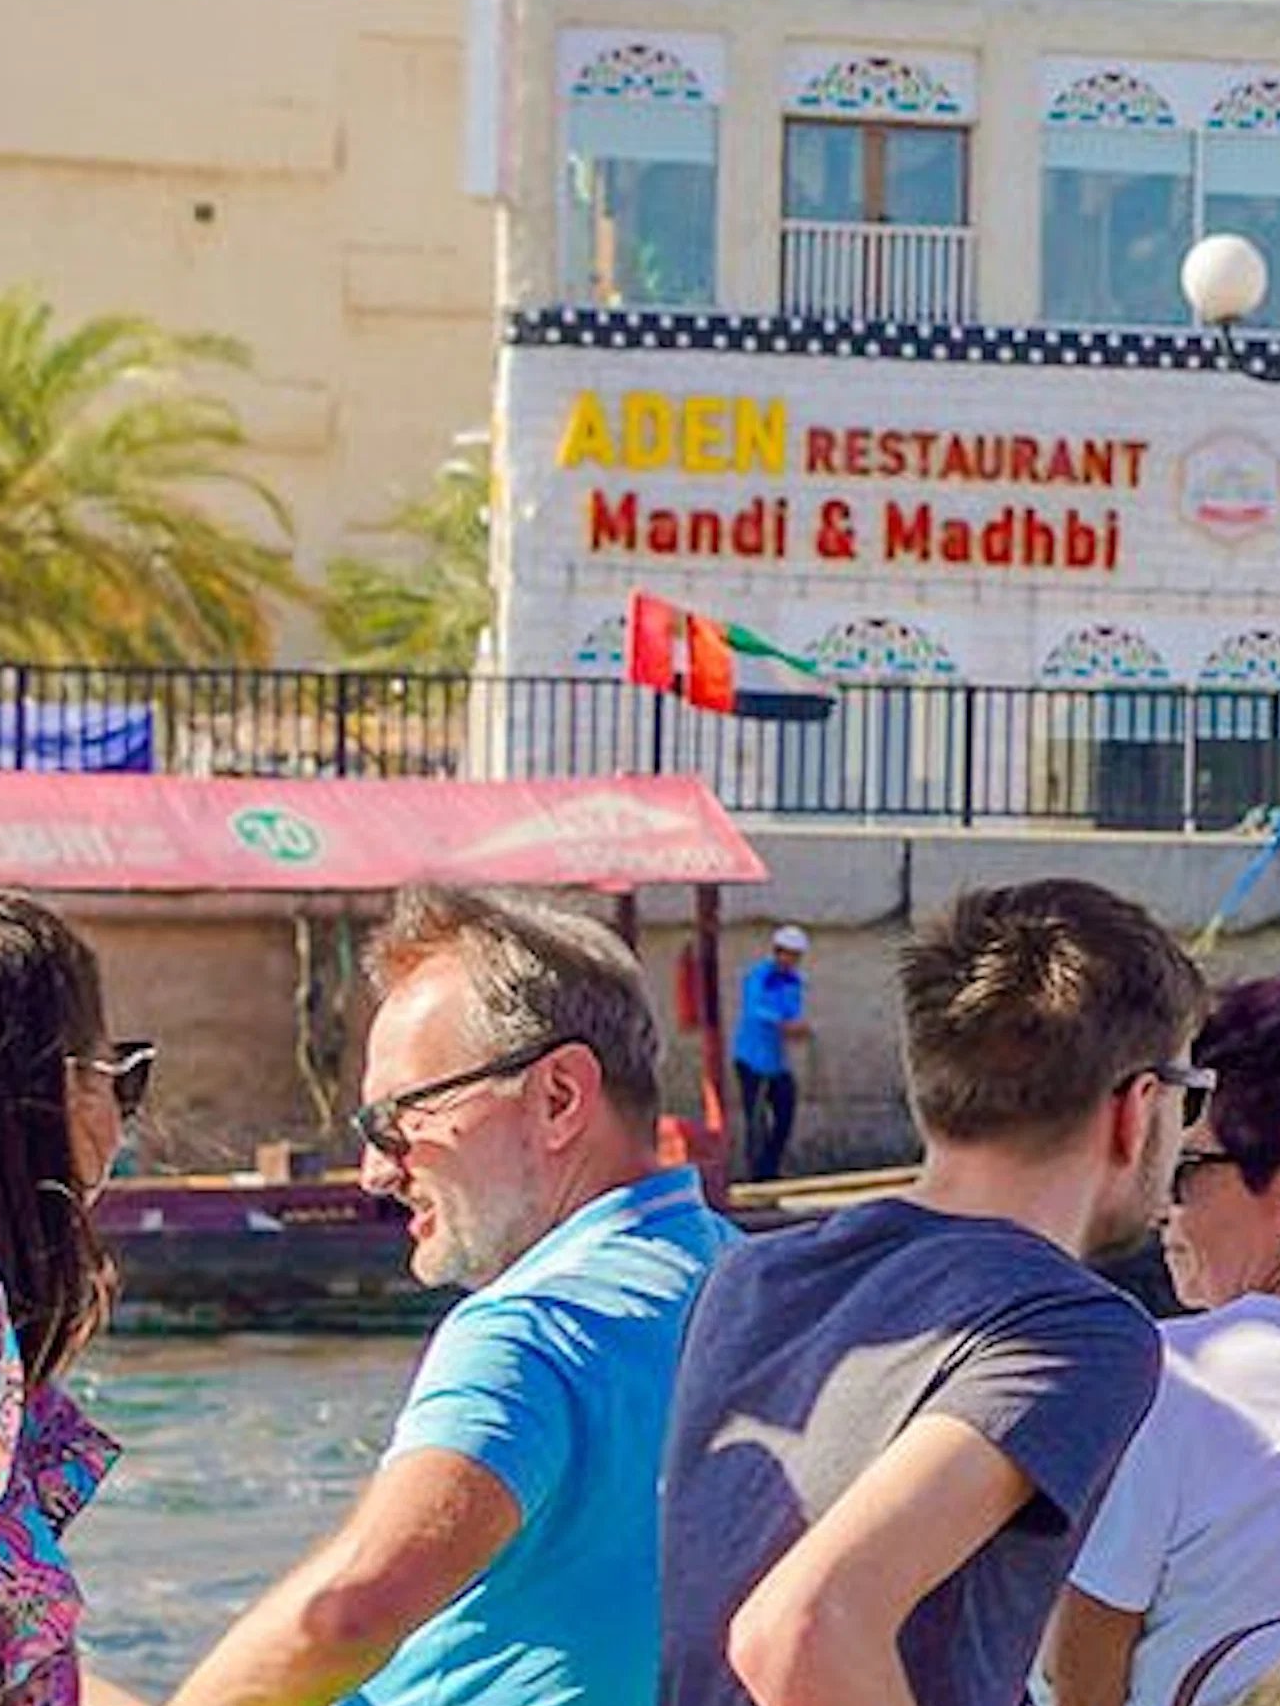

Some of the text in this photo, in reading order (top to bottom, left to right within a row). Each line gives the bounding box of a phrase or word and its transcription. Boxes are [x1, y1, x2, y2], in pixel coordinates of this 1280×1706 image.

[556, 389, 1150, 488] ADEN RESTAURANT
[589, 487, 1121, 573] Mandi & Madhbi
